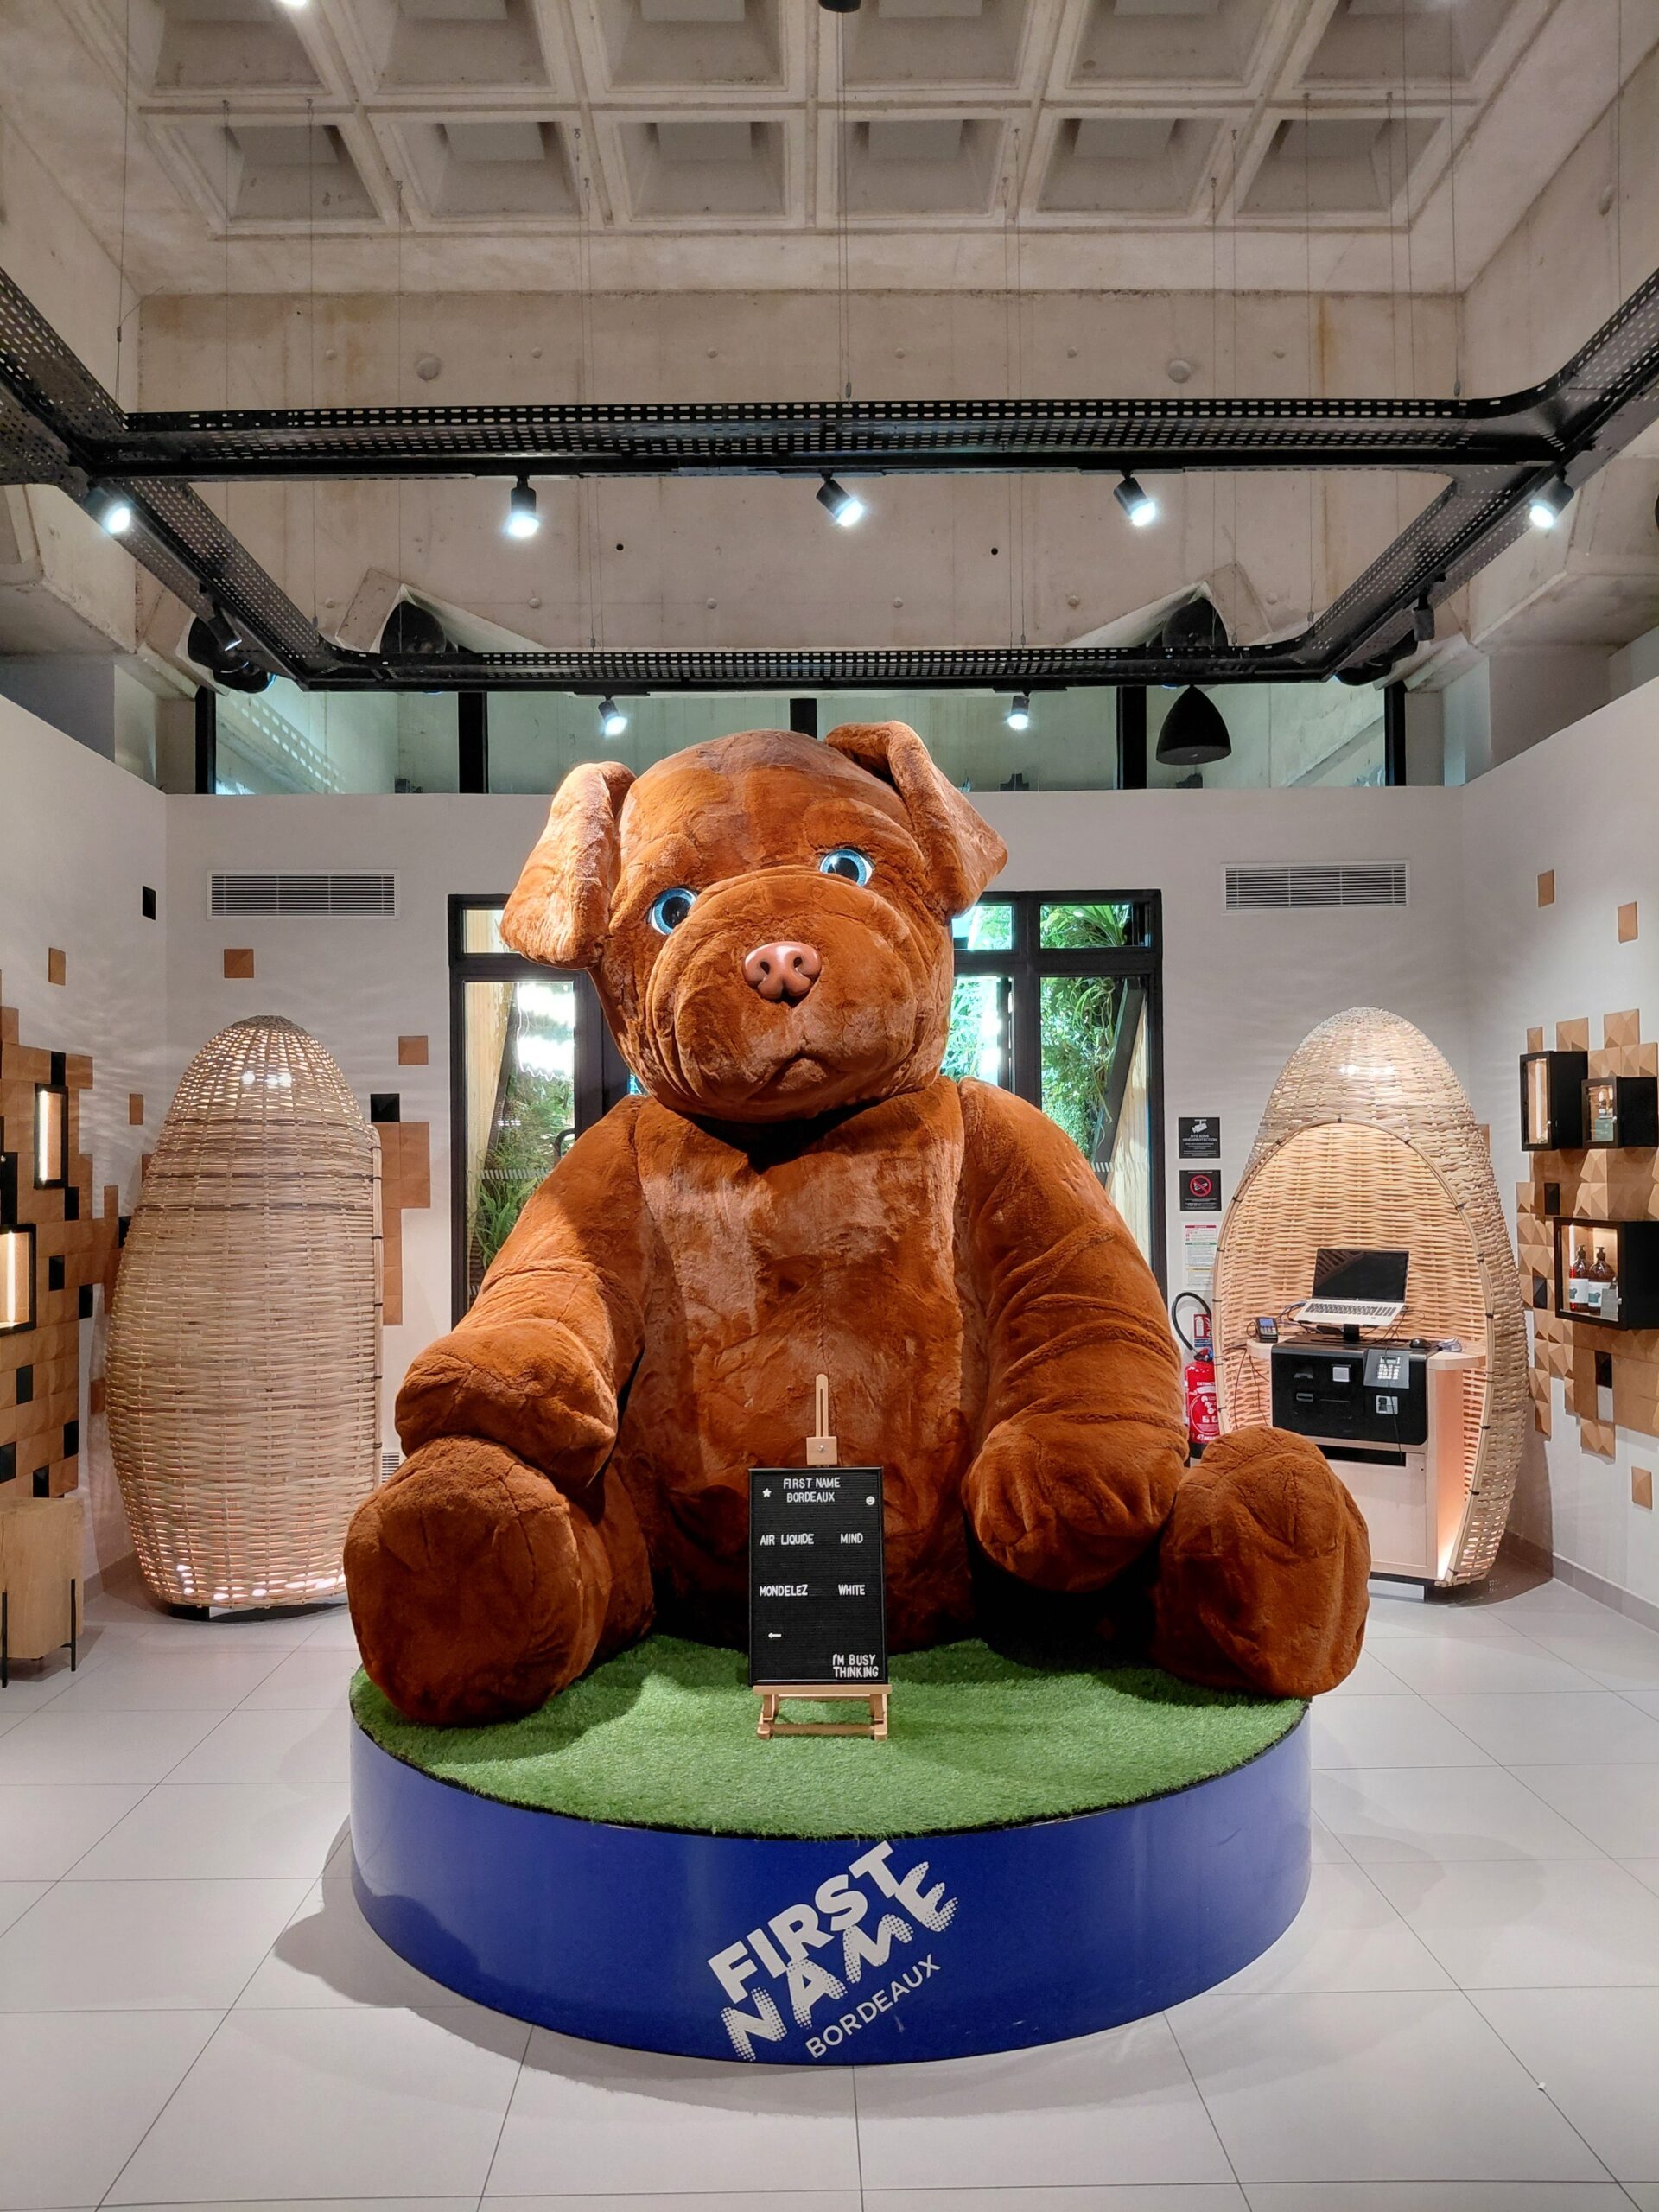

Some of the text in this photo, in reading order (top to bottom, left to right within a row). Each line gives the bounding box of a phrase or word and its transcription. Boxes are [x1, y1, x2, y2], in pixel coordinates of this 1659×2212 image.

[783, 1477, 841, 1489] FIRST NAME
[786, 1491, 836, 1503] BORDEAUX
[760, 1533, 815, 1546] AIR LIQUIDE
[840, 1532, 864, 1544] MIND
[759, 1584, 809, 1597] MONDELEZ
[837, 1584, 866, 1596] WHITE
[832, 1653, 876, 1666] I'M BUSY
[833, 1666, 880, 1678] THINKING
[707, 1840, 901, 2004] FIRST
[720, 1860, 959, 2062] NAME
[804, 1954, 942, 2059] BORDEAUX
